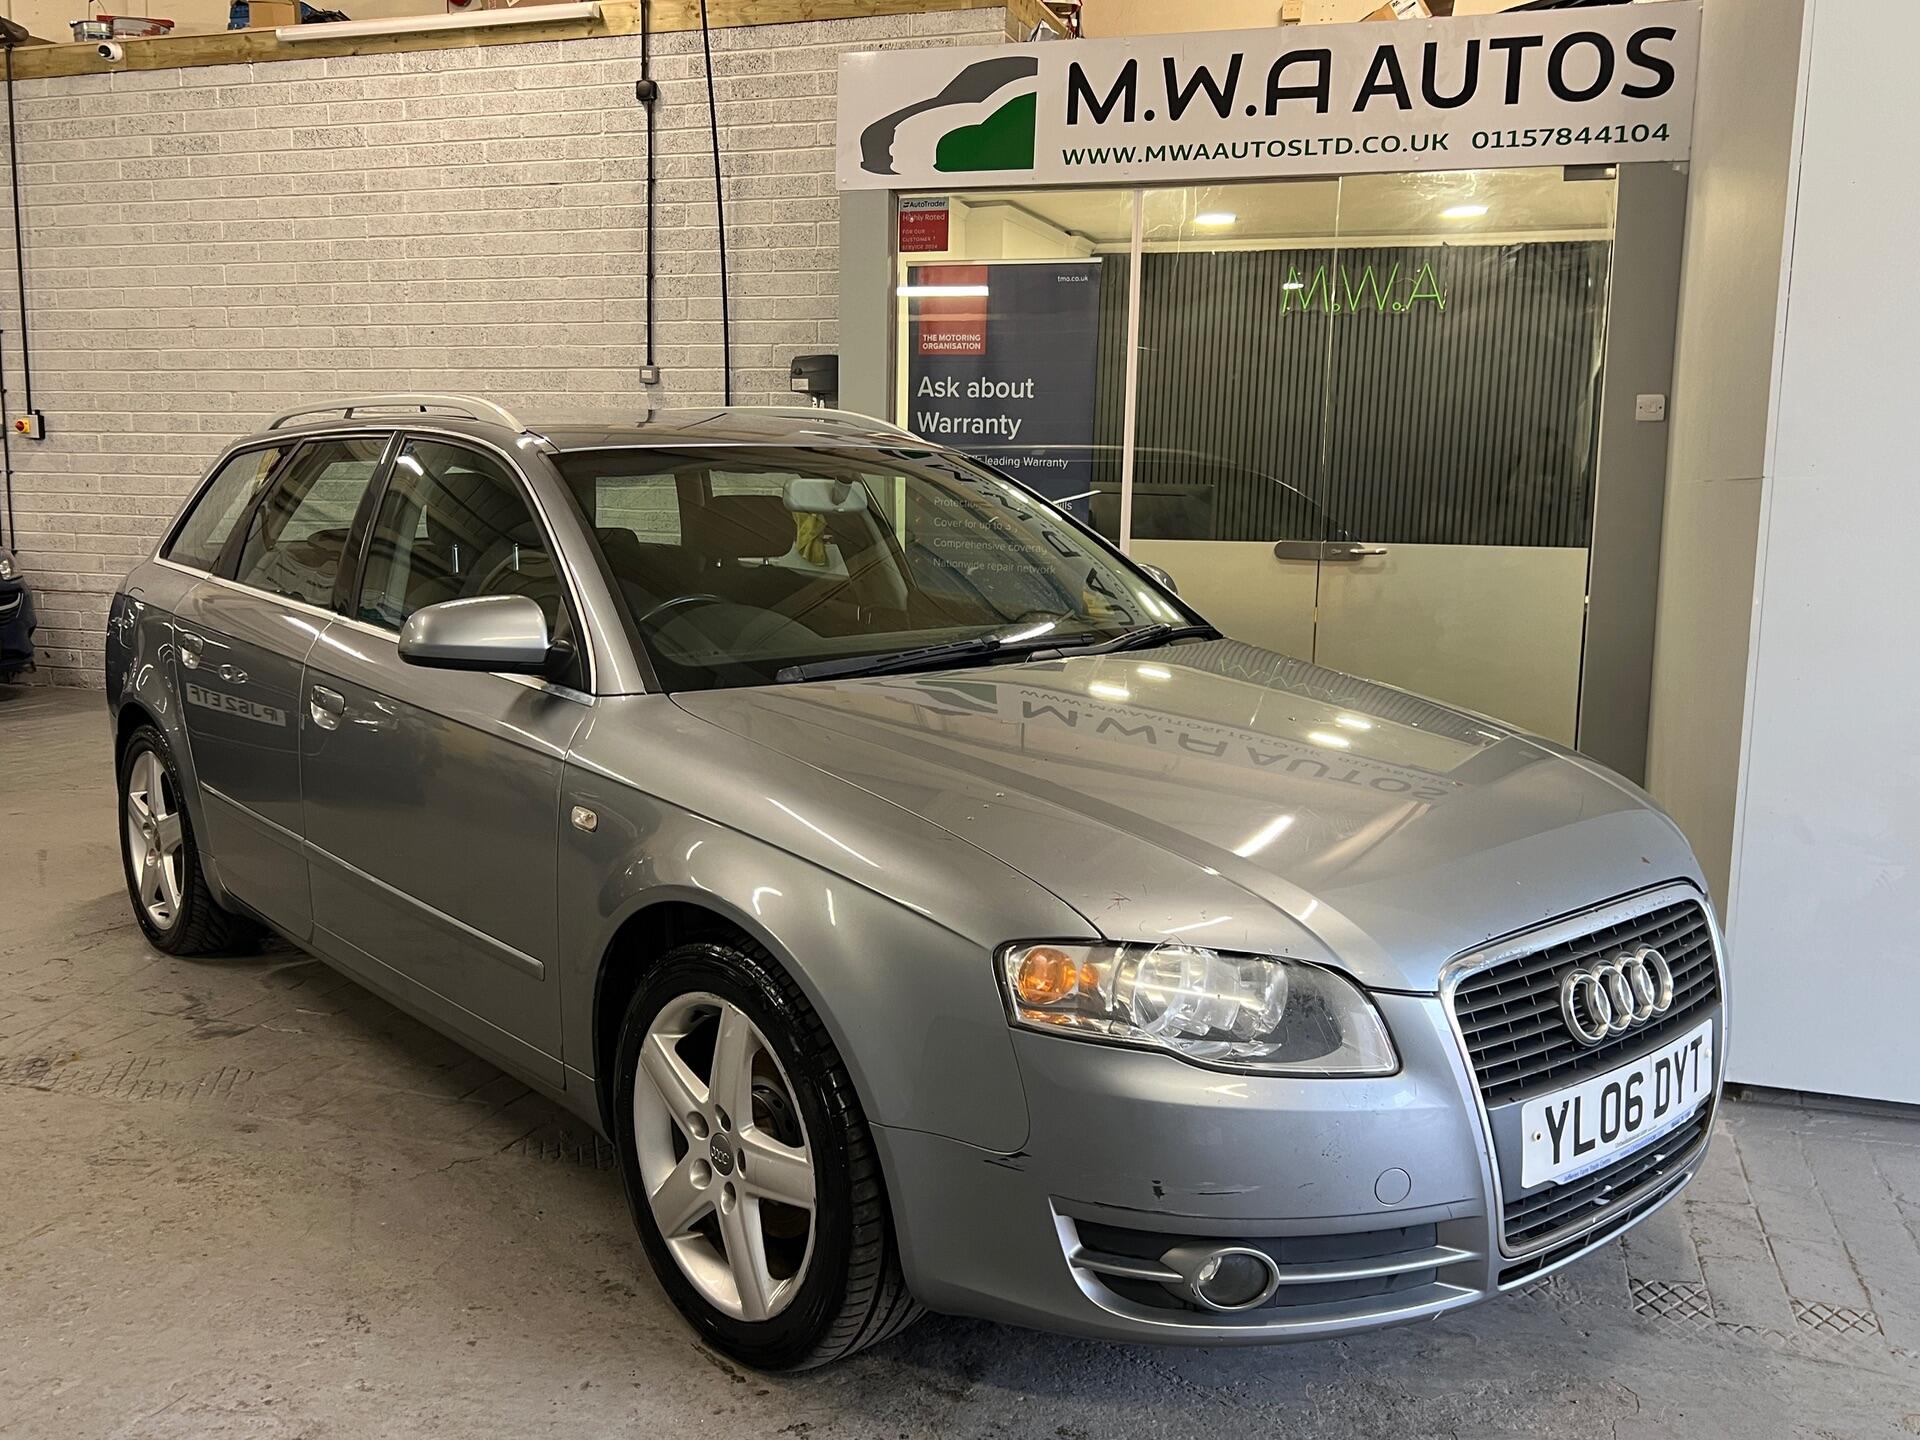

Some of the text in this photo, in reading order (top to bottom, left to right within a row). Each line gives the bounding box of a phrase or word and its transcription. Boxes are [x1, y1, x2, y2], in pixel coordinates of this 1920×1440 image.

[1066, 26, 1677, 125] M.W.A AUTOS
[1062, 123, 1670, 166] WWW.MWAAUTOSLTD.CO.UK 01157844104
[909, 200, 946, 208] AutoTrader
[924, 213, 946, 221] Rated
[1056, 274, 1089, 283] tmo.co.uk
[922, 334, 981, 342] THE MOTORING
[922, 342, 981, 350] ORGANISATION
[917, 376, 1035, 399] Ask about
[917, 411, 1022, 440] Warranty
[984, 456, 1020, 468] leading
[1023, 457, 1069, 470] Warranty
[933, 517, 962, 528] Cover
[964, 518, 977, 529] for
[933, 537, 1006, 553] Comprehensive
[933, 558, 1057, 576] Nationwide repair network
[1544, 1034, 1703, 1165] YL06 DYT
